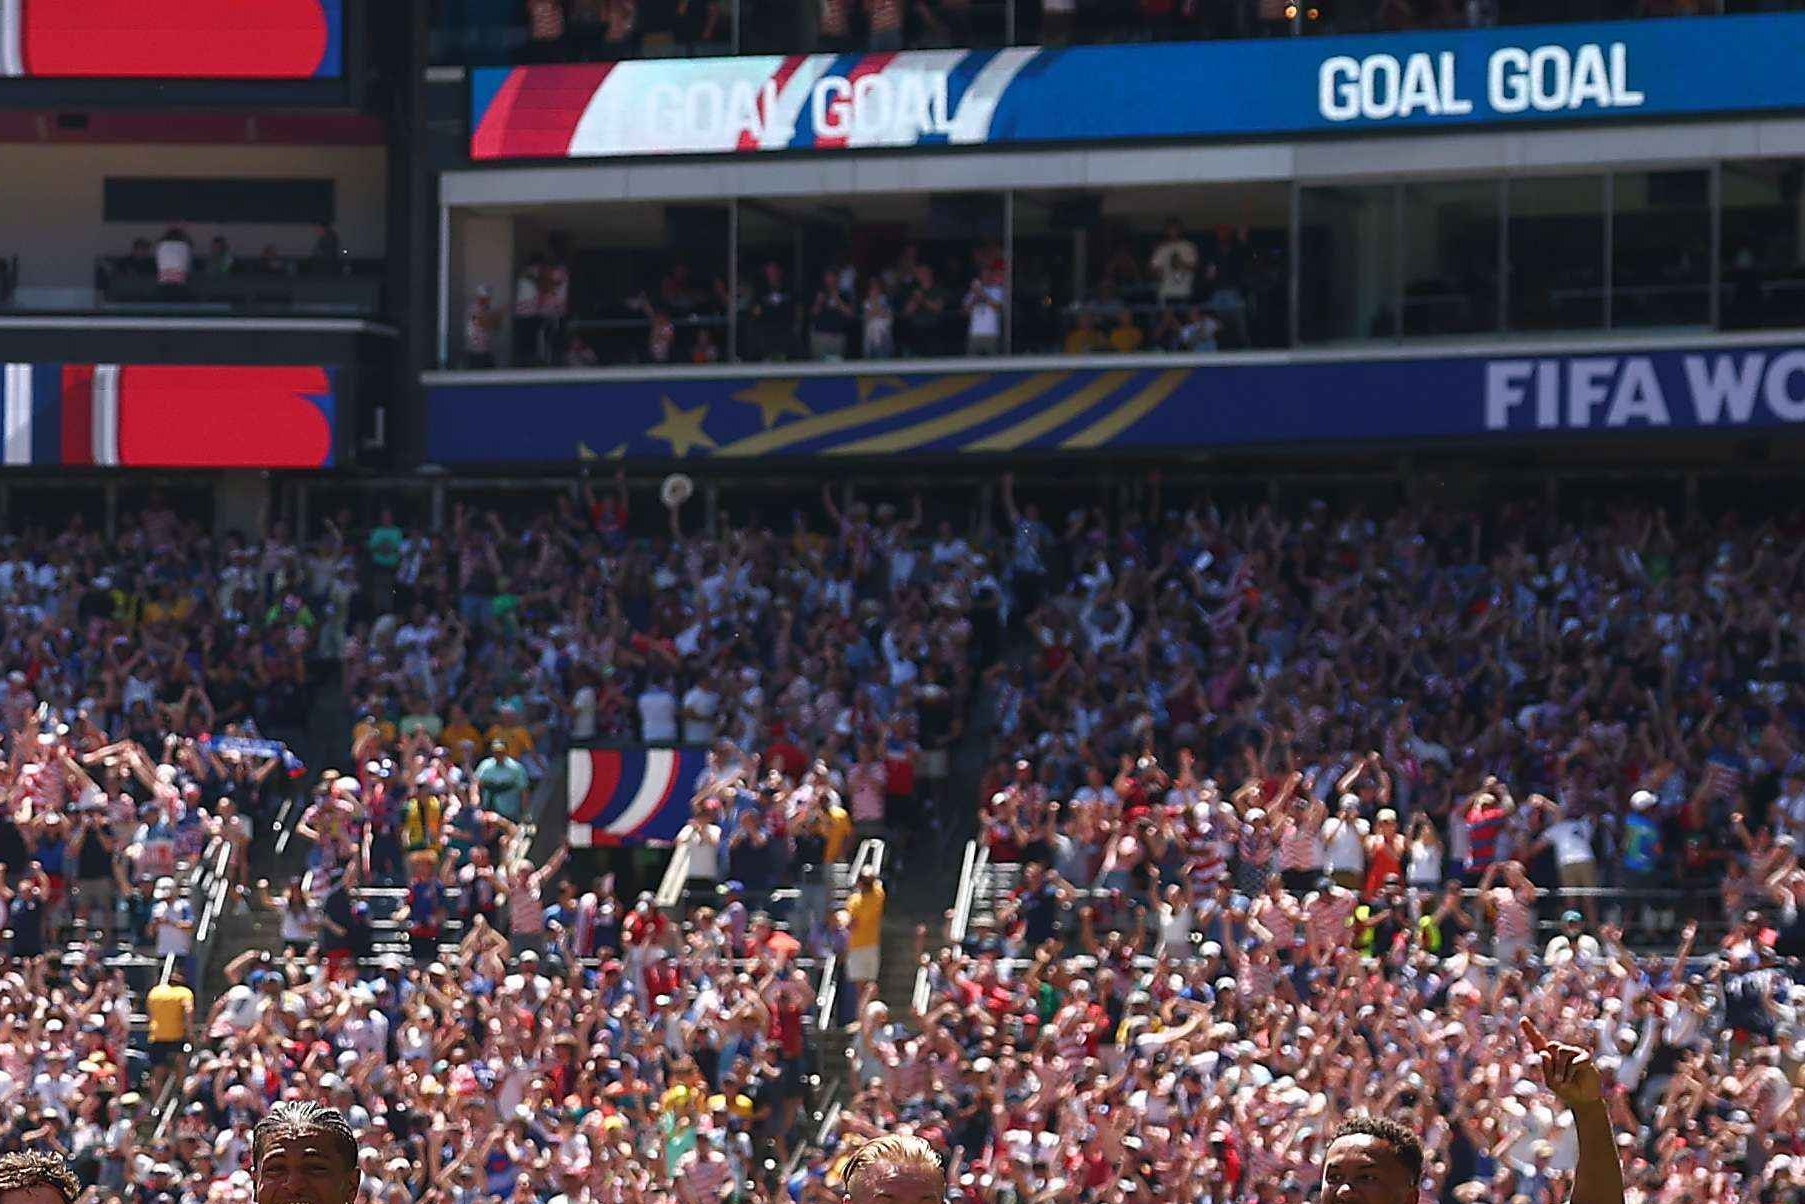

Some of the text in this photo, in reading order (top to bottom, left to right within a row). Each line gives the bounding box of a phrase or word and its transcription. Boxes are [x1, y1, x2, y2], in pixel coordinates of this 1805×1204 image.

[811, 69, 958, 137] GOAL
[1319, 42, 1645, 121] GOAL GOAL
[1485, 357, 1671, 430] FIFA
